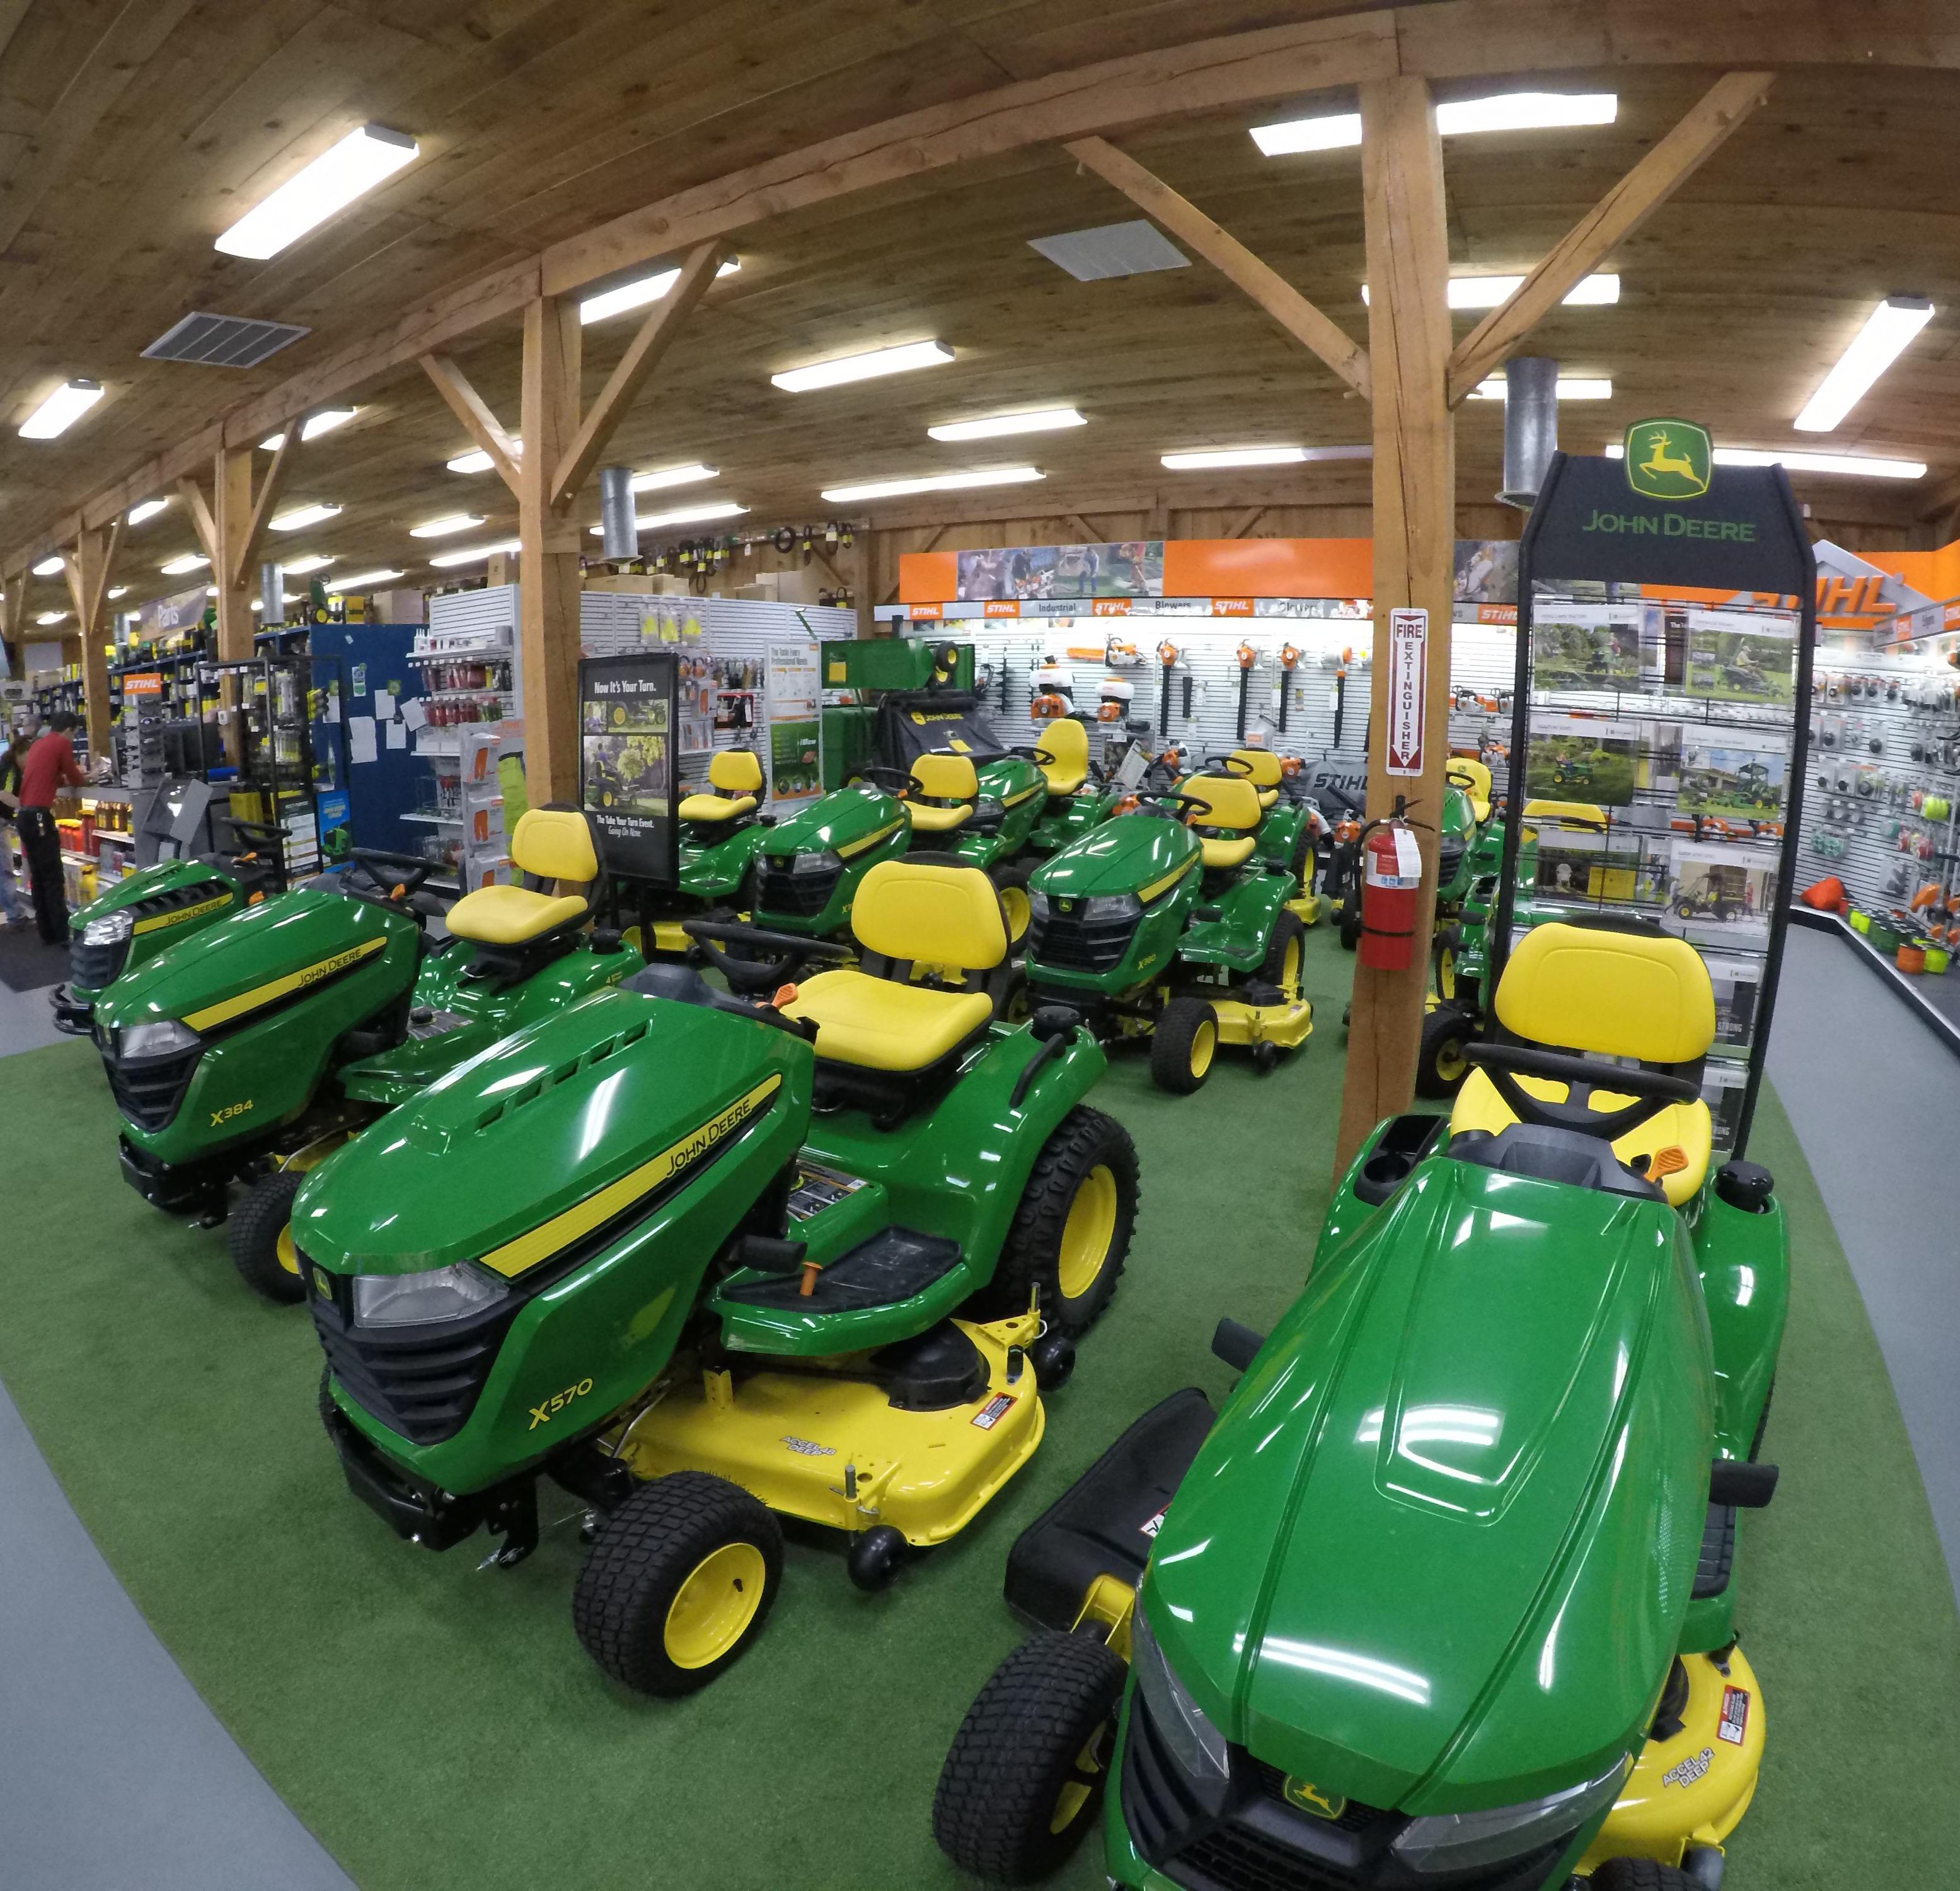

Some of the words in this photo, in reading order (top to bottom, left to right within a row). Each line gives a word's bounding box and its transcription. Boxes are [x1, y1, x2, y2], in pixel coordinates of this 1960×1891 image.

[1582, 509, 1658, 535] JOHN
[1664, 513, 1756, 542] DEERE
[912, 606, 940, 616] STIHL
[986, 604, 1016, 614] STIHL
[1039, 603, 1076, 612] Industrial
[1095, 602, 1126, 611] STIHL
[1155, 600, 1191, 610] Blowers
[1214, 600, 1249, 611] STIHL
[158, 603, 179, 627] Parts
[1397, 624, 1422, 639] FIRE
[125, 679, 159, 690] STIHL
[594, 681, 609, 694] Now
[609, 681, 621, 693] It's
[621, 680, 638, 693] Your
[638, 679, 657, 692] Turn.
[1401, 641, 1414, 760] EXTINGUISHER
[596, 814, 605, 824] The
[605, 815, 616, 825] Take
[616, 816, 627, 826] Your
[627, 817, 638, 826] Turn
[608, 826, 621, 838] Going
[621, 827, 629, 836] On
[165, 910, 192, 925] JOHN
[192, 899, 222, 916] DEERE
[298, 966, 327, 987] JOHN
[328, 949, 361, 971] DEERE
[210, 1099, 253, 1127] X384
[667, 1135, 706, 1176] JOHN
[708, 1099, 751, 1142] DEERE
[529, 1378, 593, 1431] X570
[781, 1436, 820, 1451] ACCEL
[787, 1444, 822, 1456] DEEP
[1663, 1757, 1700, 1788] ACCEL
[1678, 1761, 1710, 1788] DEEP
